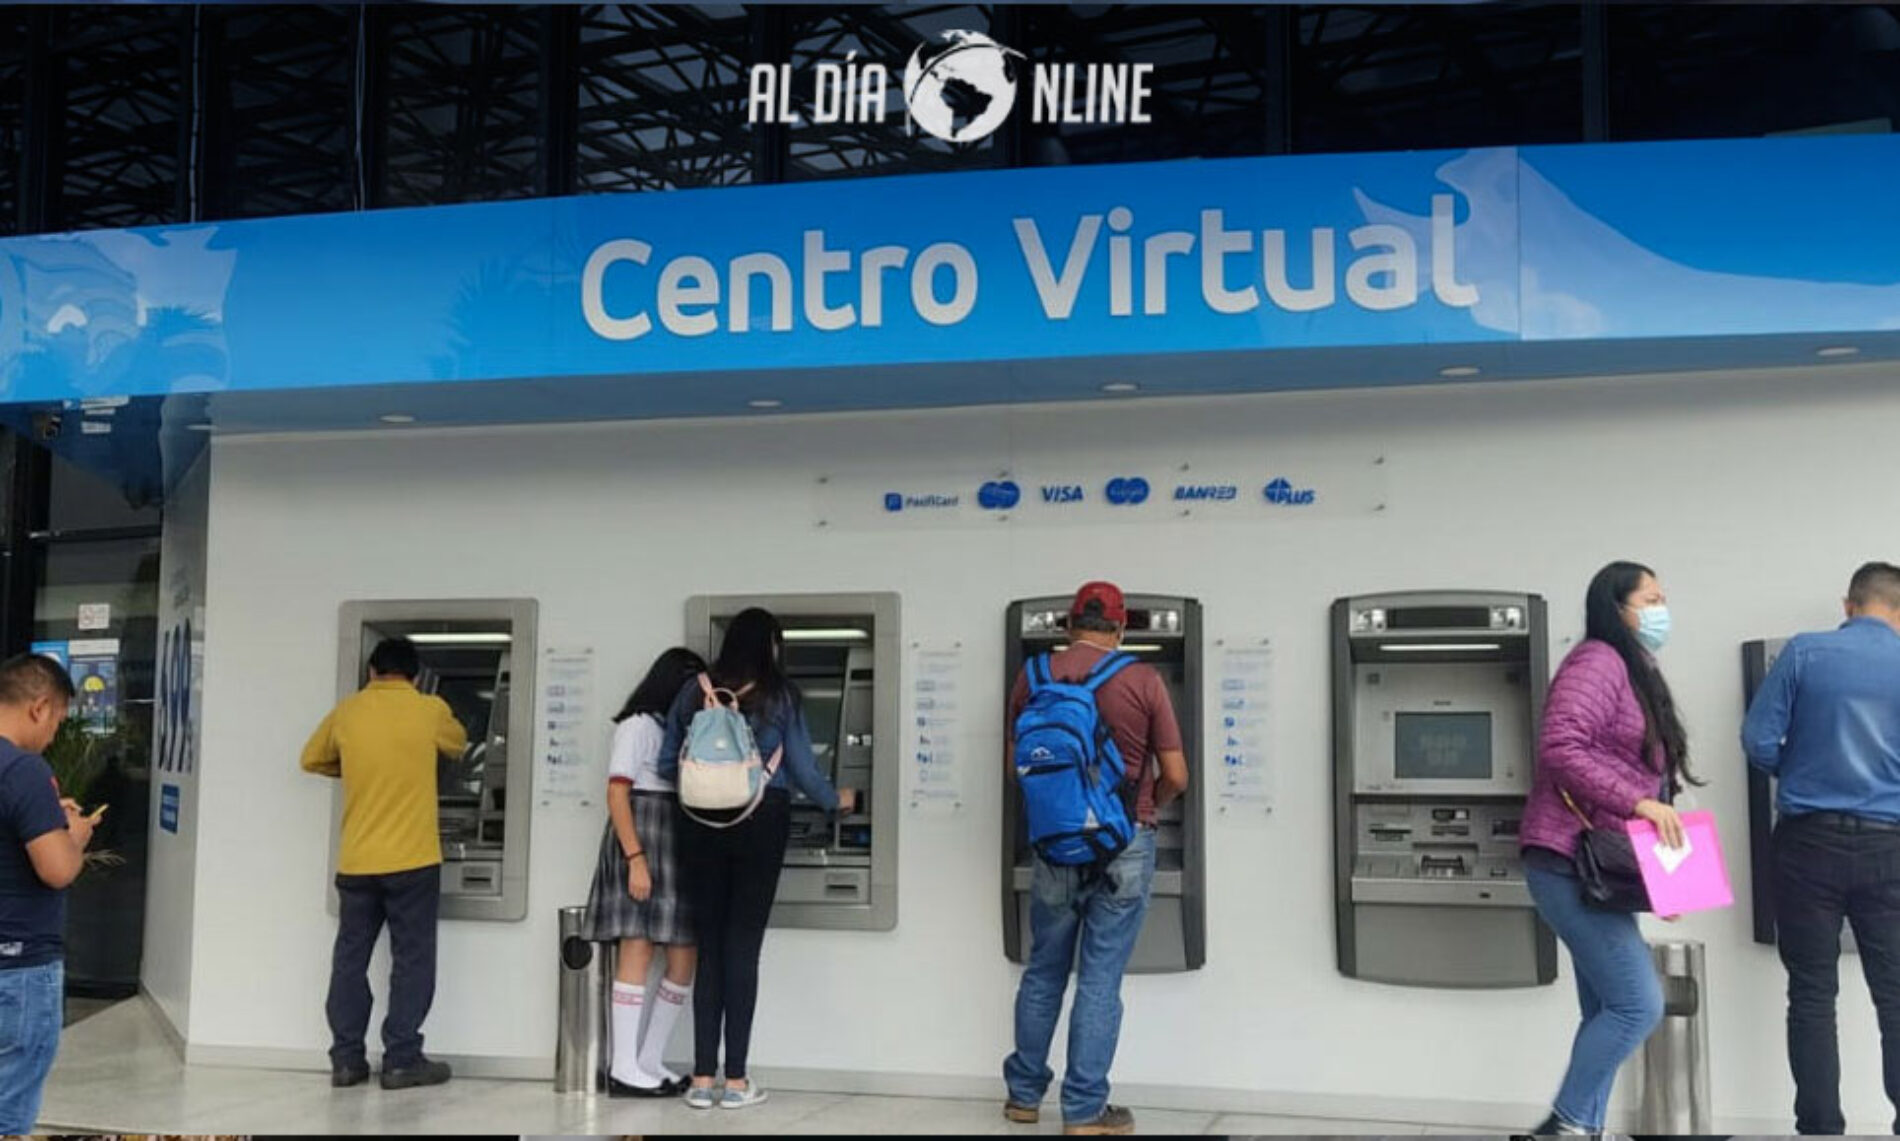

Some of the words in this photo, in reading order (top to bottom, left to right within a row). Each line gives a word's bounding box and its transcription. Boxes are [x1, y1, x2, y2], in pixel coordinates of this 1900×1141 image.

[581, 229, 979, 341] Centro
[1012, 193, 1480, 319] Virtual
[1041, 485, 1084, 503] VISA
[1173, 485, 1238, 501] BANRED
[1276, 488, 1316, 505] PLUS
